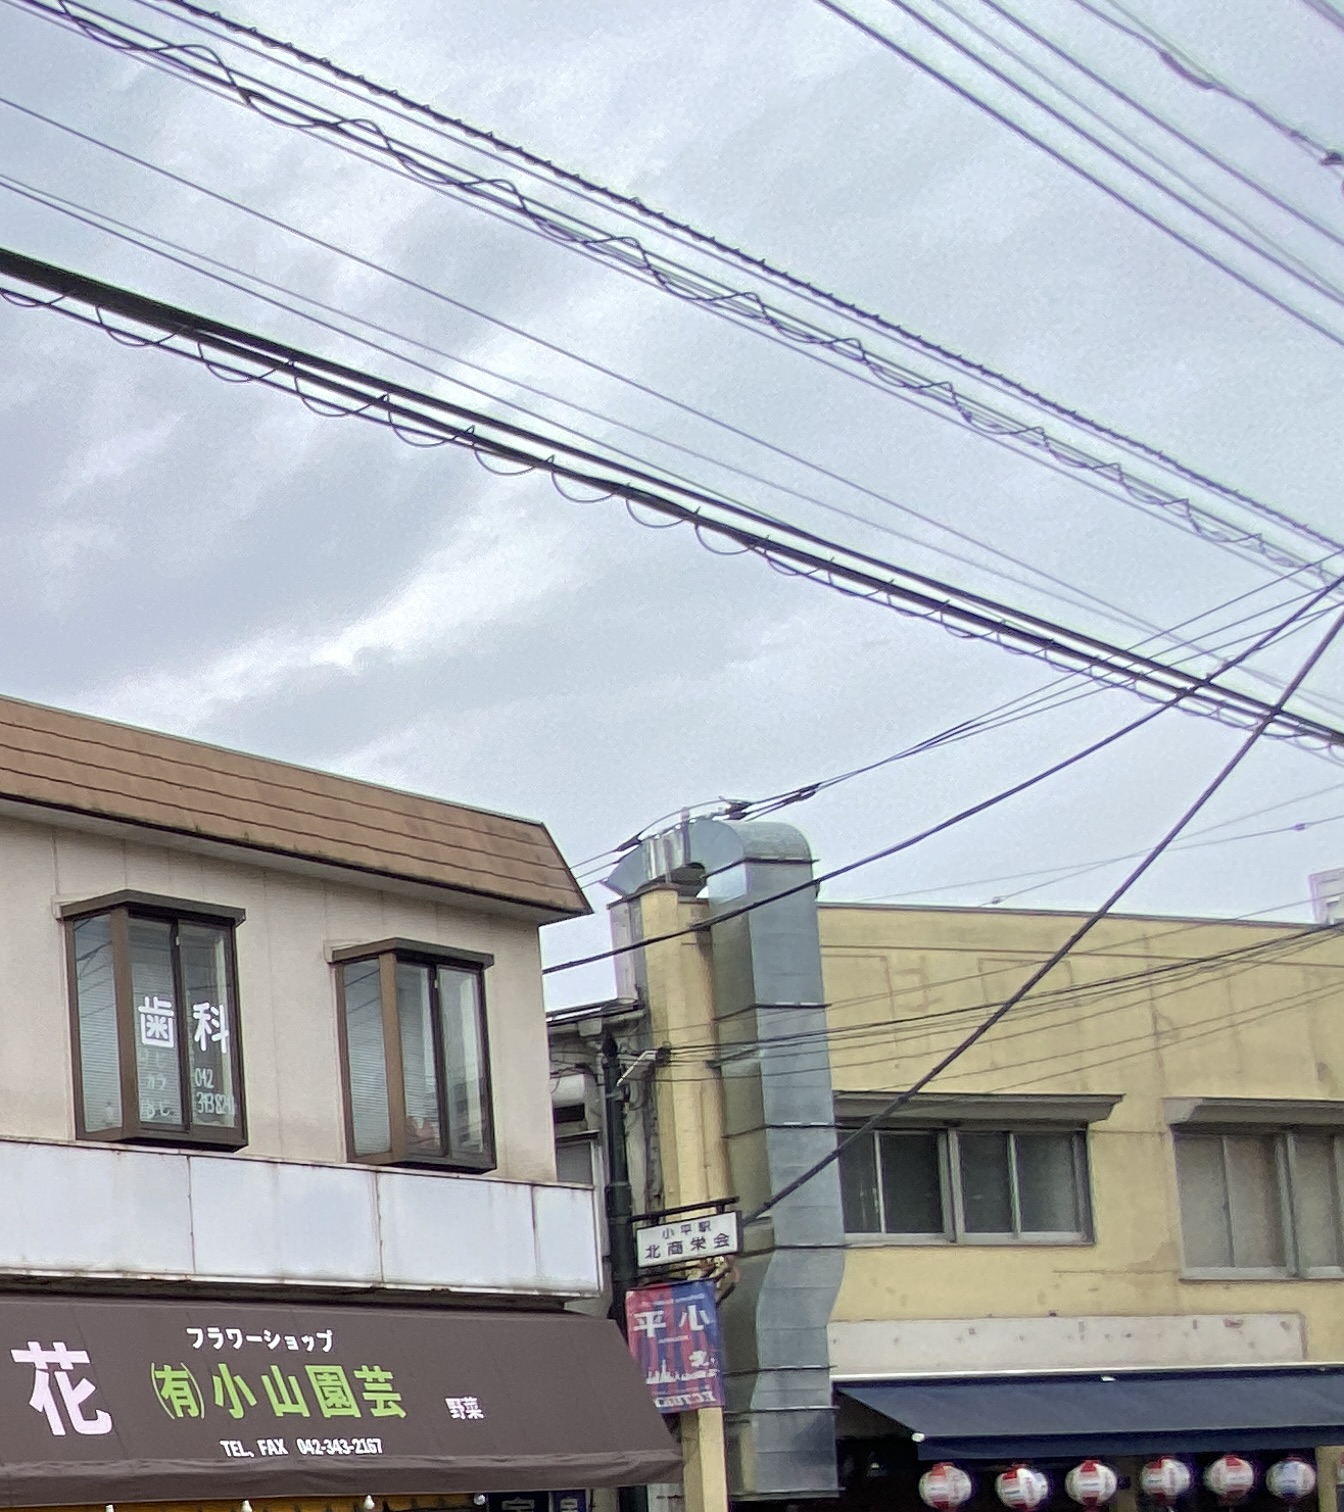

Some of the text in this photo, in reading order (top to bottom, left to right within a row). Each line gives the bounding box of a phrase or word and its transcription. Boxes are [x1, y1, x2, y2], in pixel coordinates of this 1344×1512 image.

[138, 996, 229, 1054] 歯科
[194, 1067, 214, 1088] 042
[663, 1219, 712, 1240] 小平駅
[645, 1233, 730, 1259] 北商栄会
[187, 1327, 333, 1352] フラワーショップ
[12, 1341, 112, 1436] 花
[445, 1396, 484, 1420] 野菜
[256, 1438, 288, 1456] FAX
[296, 1438, 383, 1456] 042-343-2167
